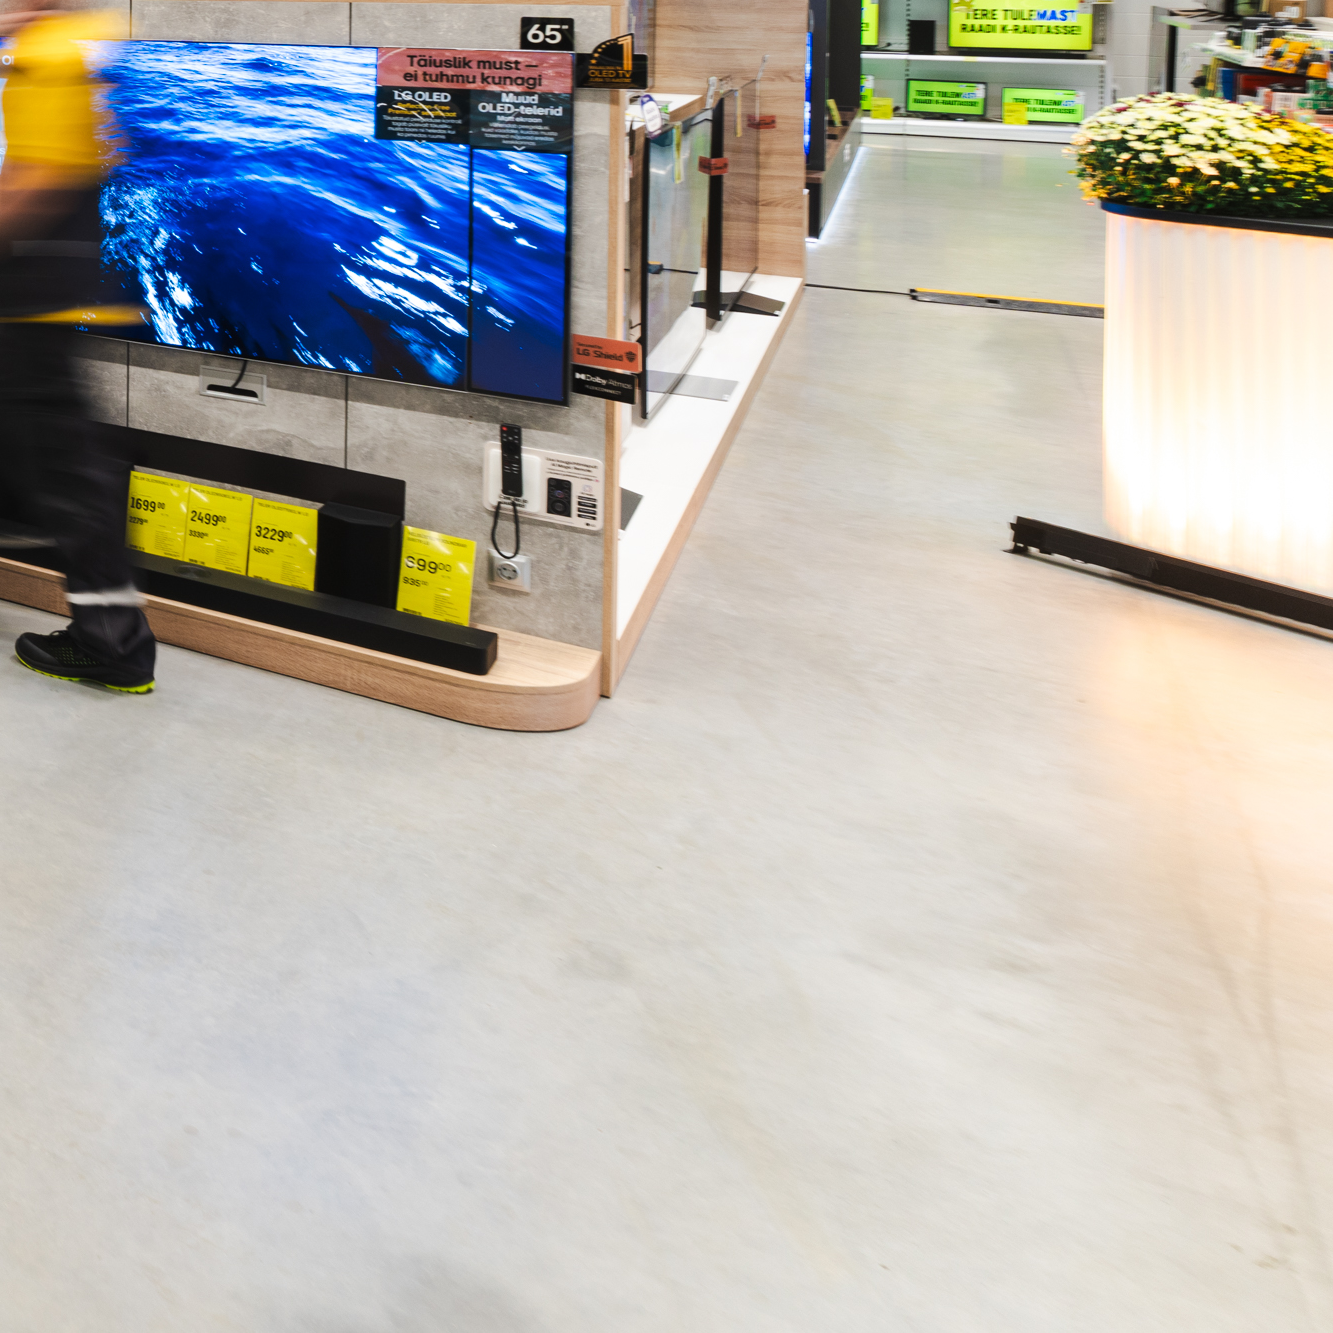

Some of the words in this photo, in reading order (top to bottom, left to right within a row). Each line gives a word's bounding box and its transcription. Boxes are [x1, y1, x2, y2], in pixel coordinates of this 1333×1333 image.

[407, 55, 472, 69] Täiuslik
[477, 59, 521, 71] must
[404, 70, 417, 81] ei
[423, 70, 476, 84] tuhmu
[481, 73, 542, 89] kunagi
[589, 70, 615, 78] OLED
[394, 91, 412, 101] LG
[417, 91, 451, 102] OLED
[501, 93, 538, 104] Muud
[478, 103, 563, 116] OLED-telerid
[576, 348, 590, 356] LG
[593, 350, 623, 362] Shield
[585, 374, 607, 385] Dolby
[130, 497, 156, 512] 1699
[191, 510, 218, 527] 2499
[189, 530, 204, 539] 3330
[255, 525, 284, 542] 3229
[405, 555, 437, 574] 699
[403, 576, 421, 588] 935
